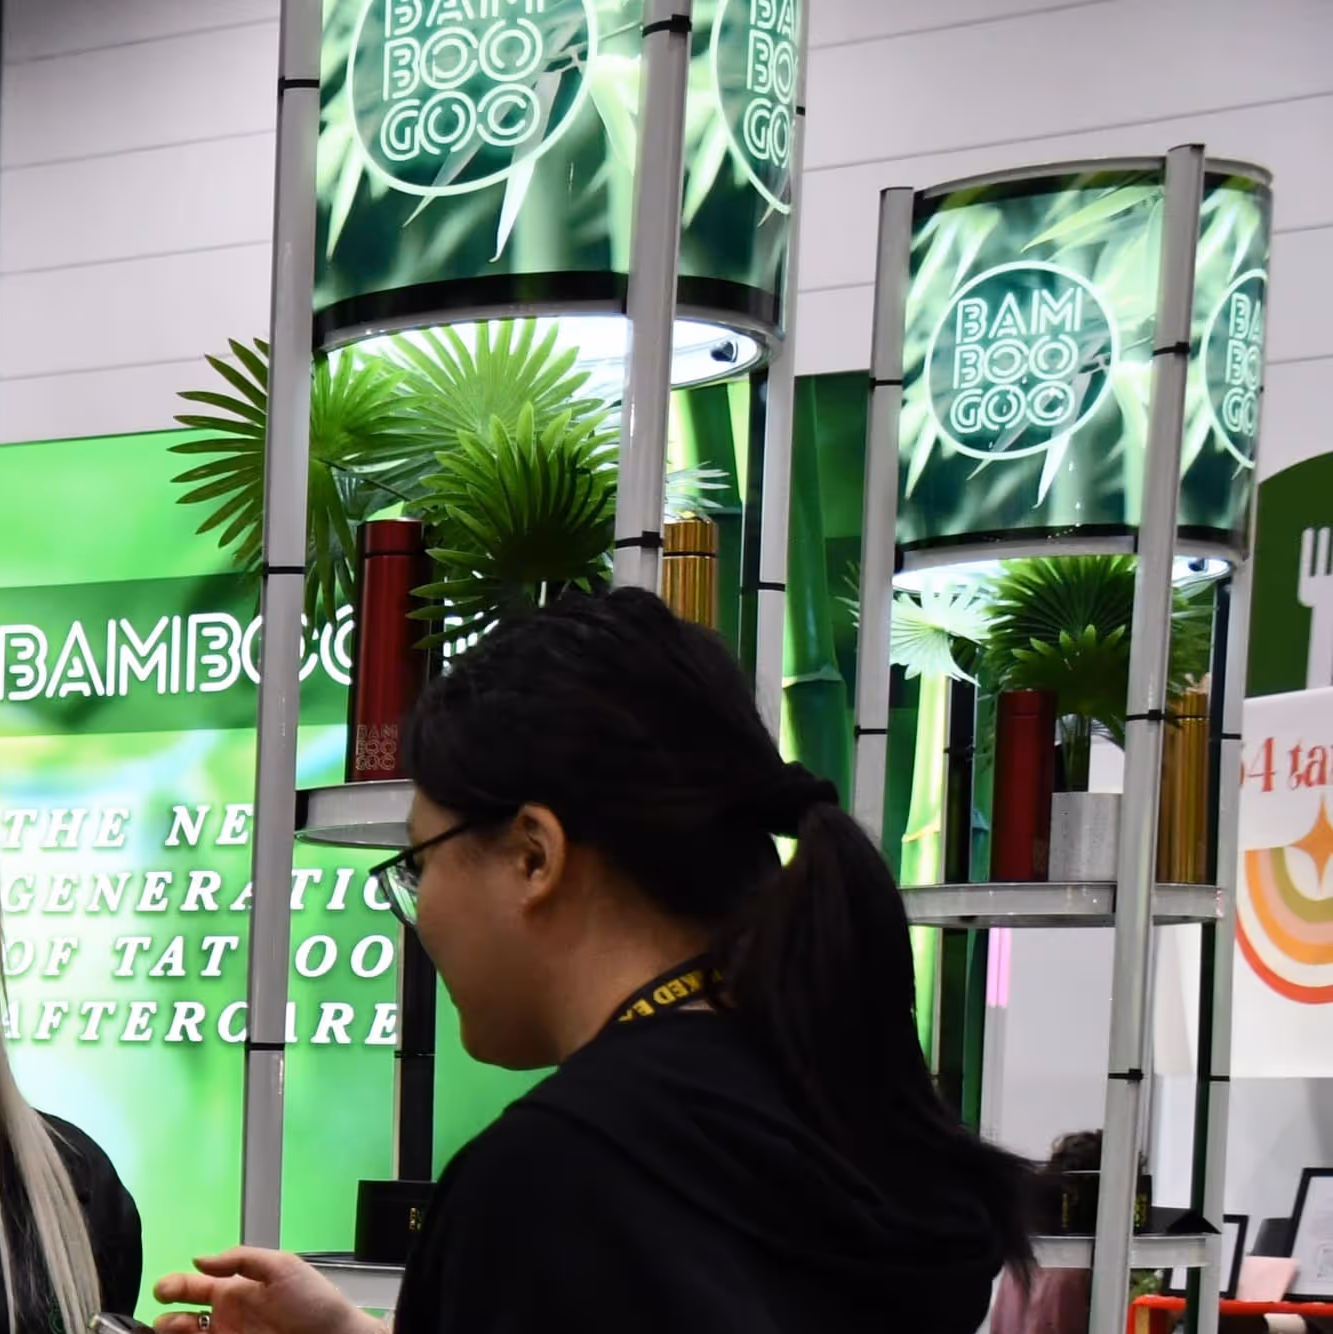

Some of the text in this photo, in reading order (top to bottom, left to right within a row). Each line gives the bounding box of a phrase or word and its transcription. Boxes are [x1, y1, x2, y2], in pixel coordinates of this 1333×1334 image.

[383, 18, 543, 100] BOO
[955, 287, 1083, 344] BAM
[953, 335, 1079, 389] BOO
[1239, 737, 1276, 793] 4
[1, 804, 254, 849] THE NE
[3, 867, 393, 913] GENERATIO
[4, 934, 395, 978] OF TATOO
[1, 1001, 398, 1046] AFTERCRE
